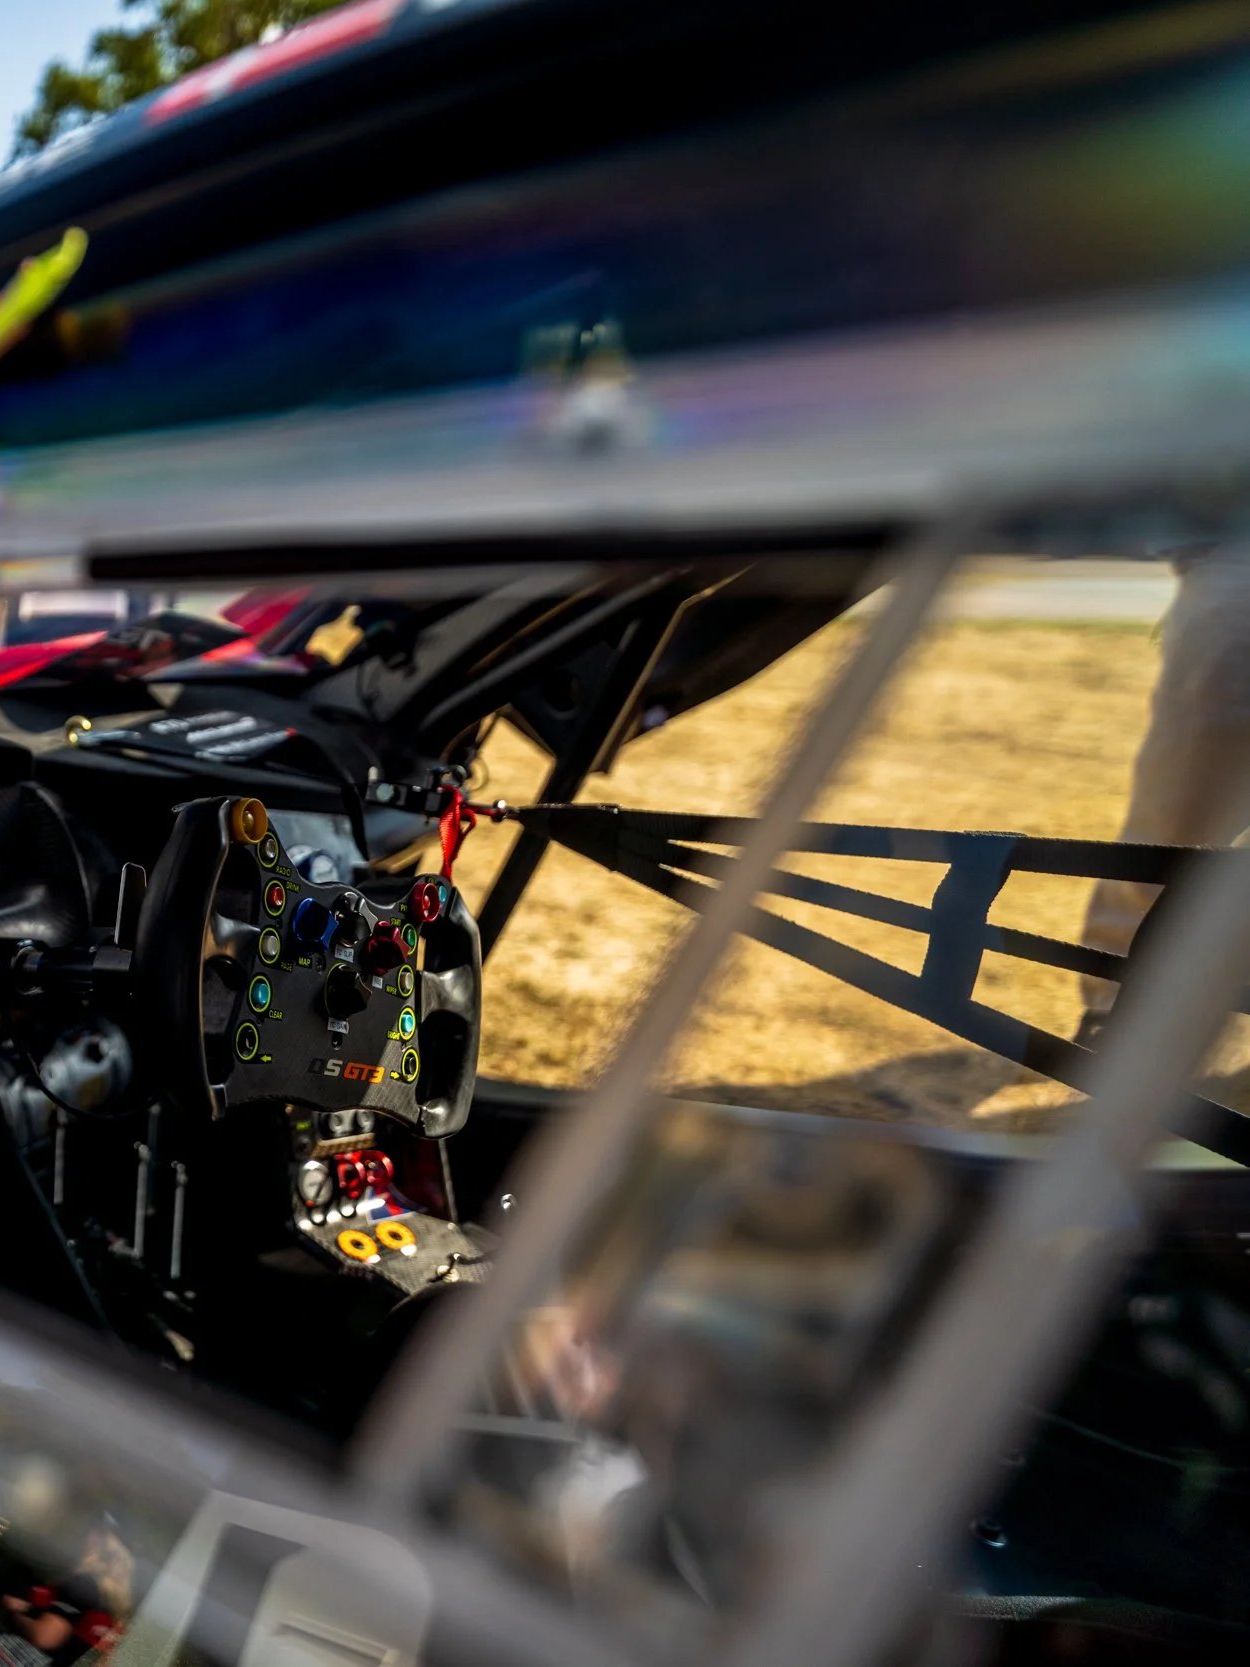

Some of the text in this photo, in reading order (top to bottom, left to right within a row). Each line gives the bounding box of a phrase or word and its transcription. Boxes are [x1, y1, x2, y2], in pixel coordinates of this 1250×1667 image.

[276, 865, 291, 877] RADIO
[298, 957, 311, 967] MAP
[268, 1009, 283, 1020] CLEAR
